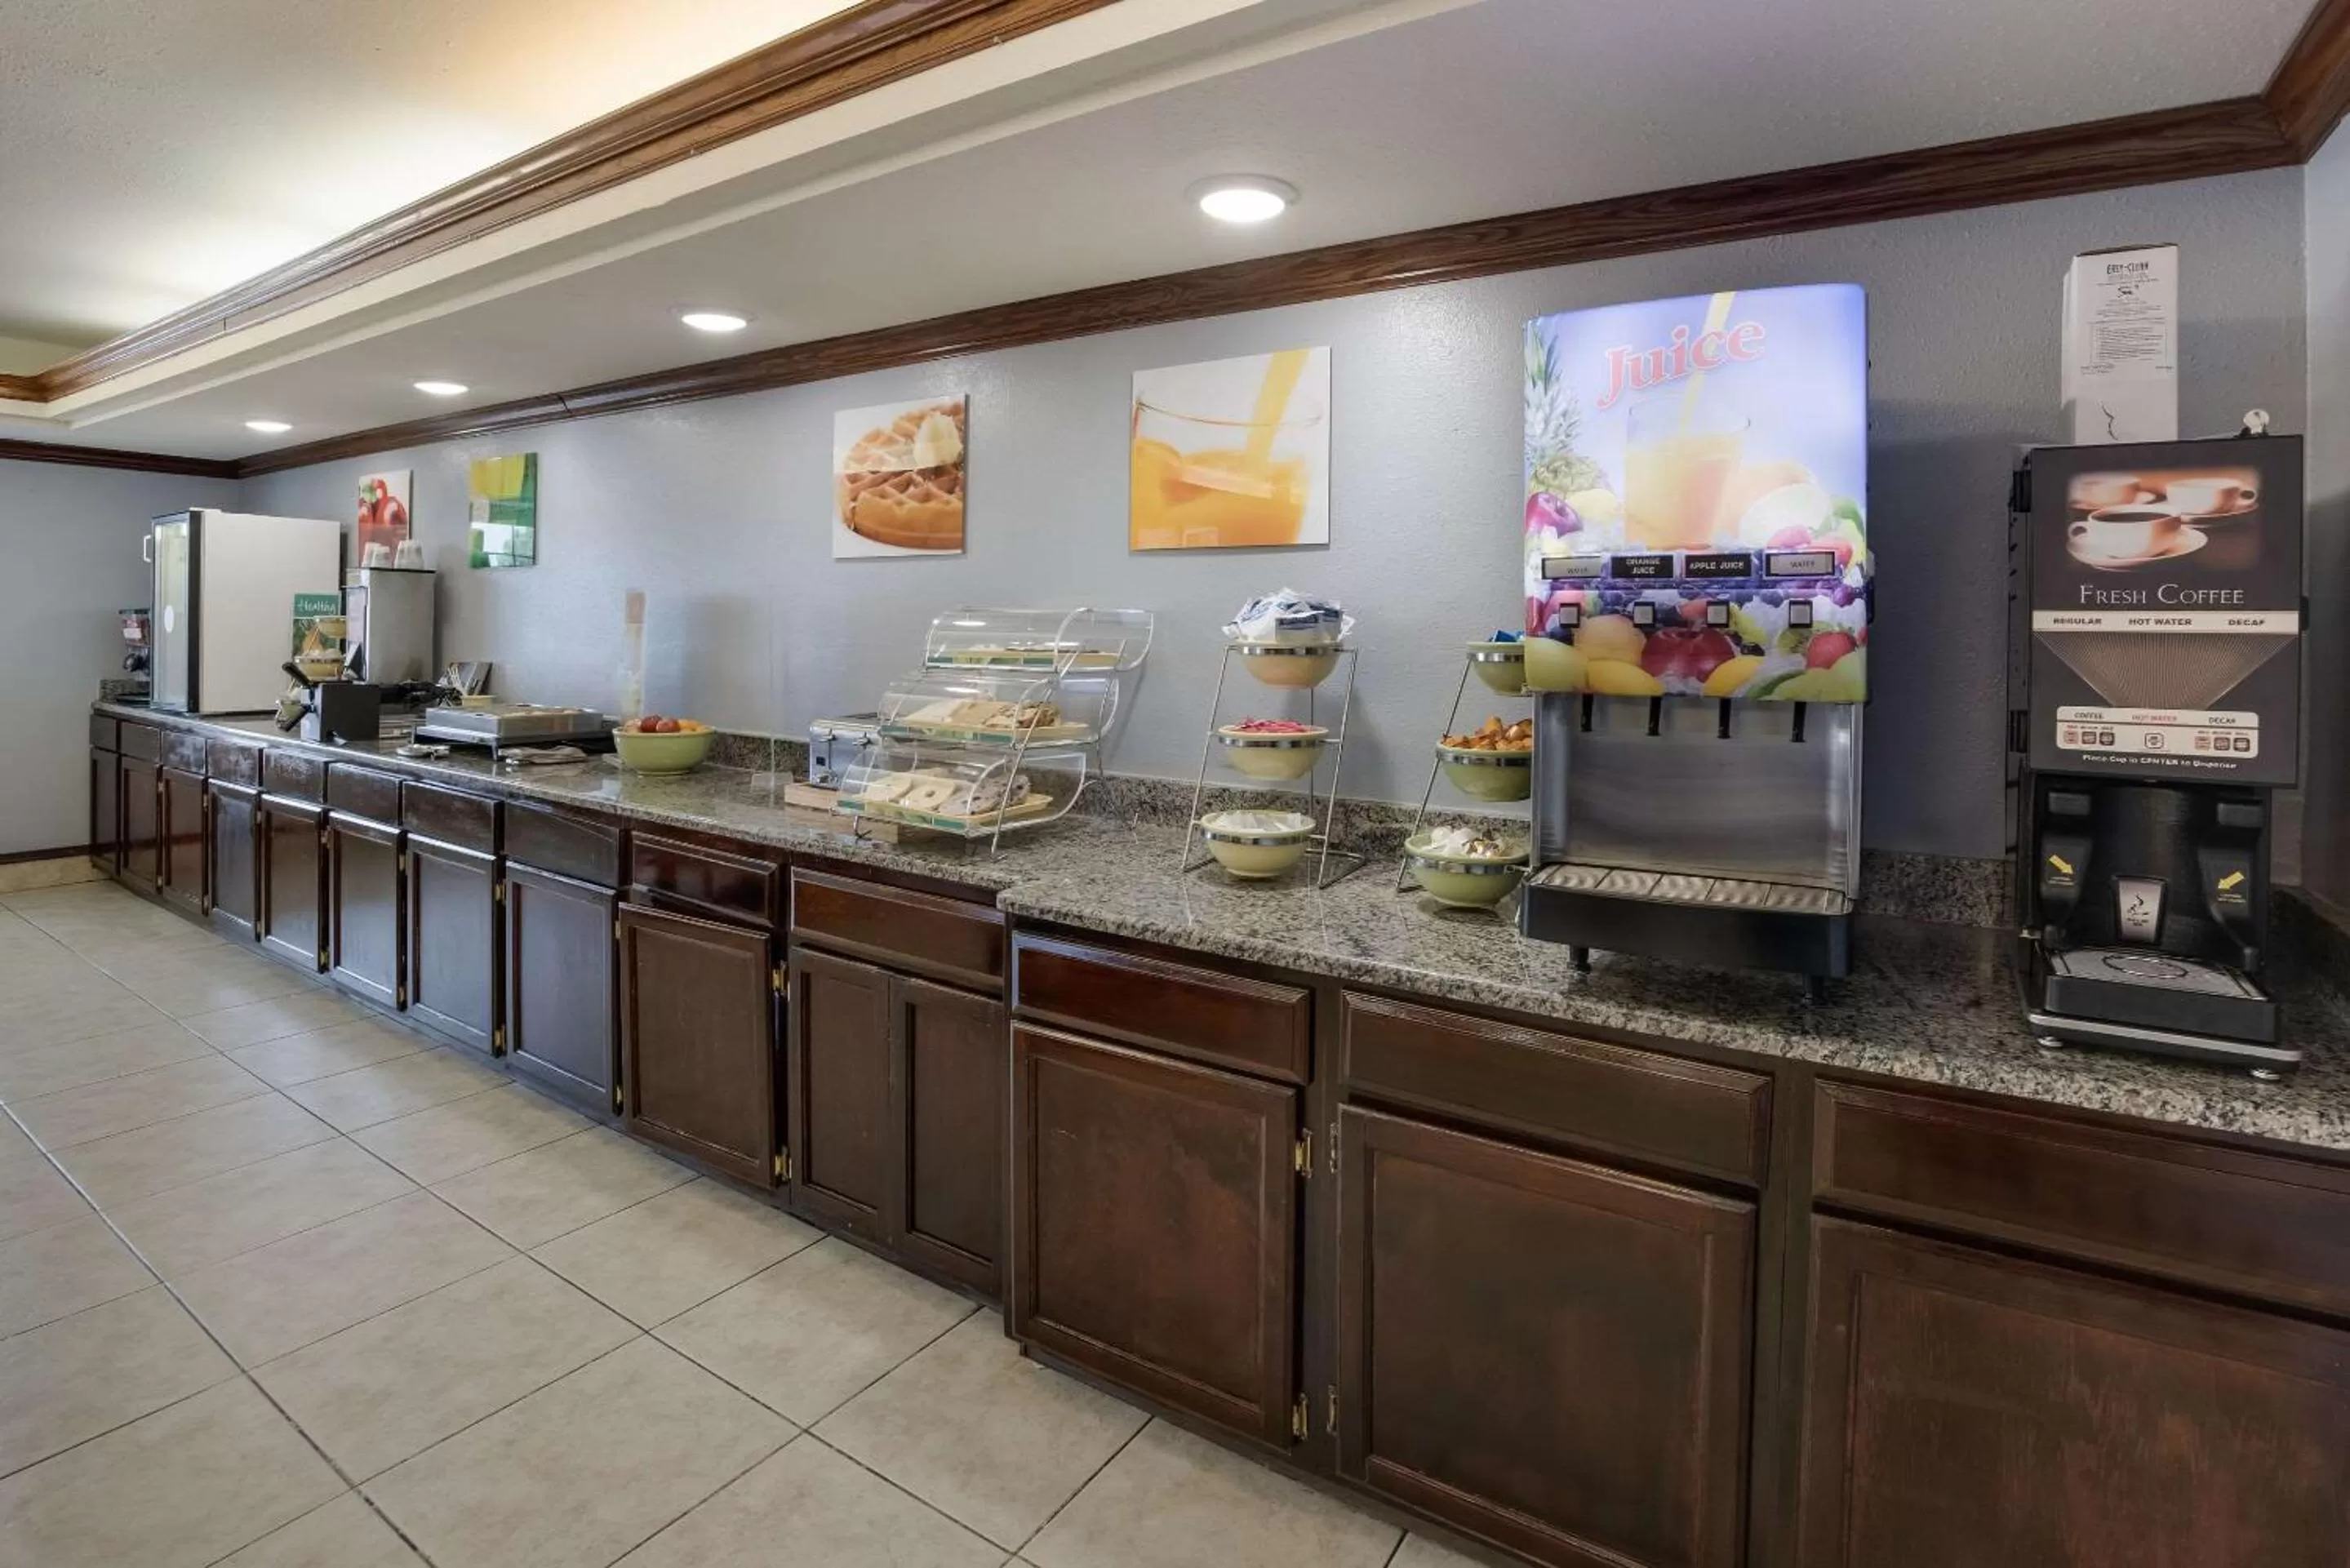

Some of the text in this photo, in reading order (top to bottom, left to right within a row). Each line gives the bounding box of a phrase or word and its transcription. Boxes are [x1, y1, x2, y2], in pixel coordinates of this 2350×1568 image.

[1596, 321, 1766, 408] Juice
[1689, 561, 1745, 571] APPLE JUICE
[2080, 584, 2245, 605] FRESH COFFEE
[2053, 617, 2103, 625] REGULAR
[2128, 617, 2192, 626] HOT WATER
[2228, 619, 2266, 627] DECAF
[2109, 756, 2127, 765] Cup
